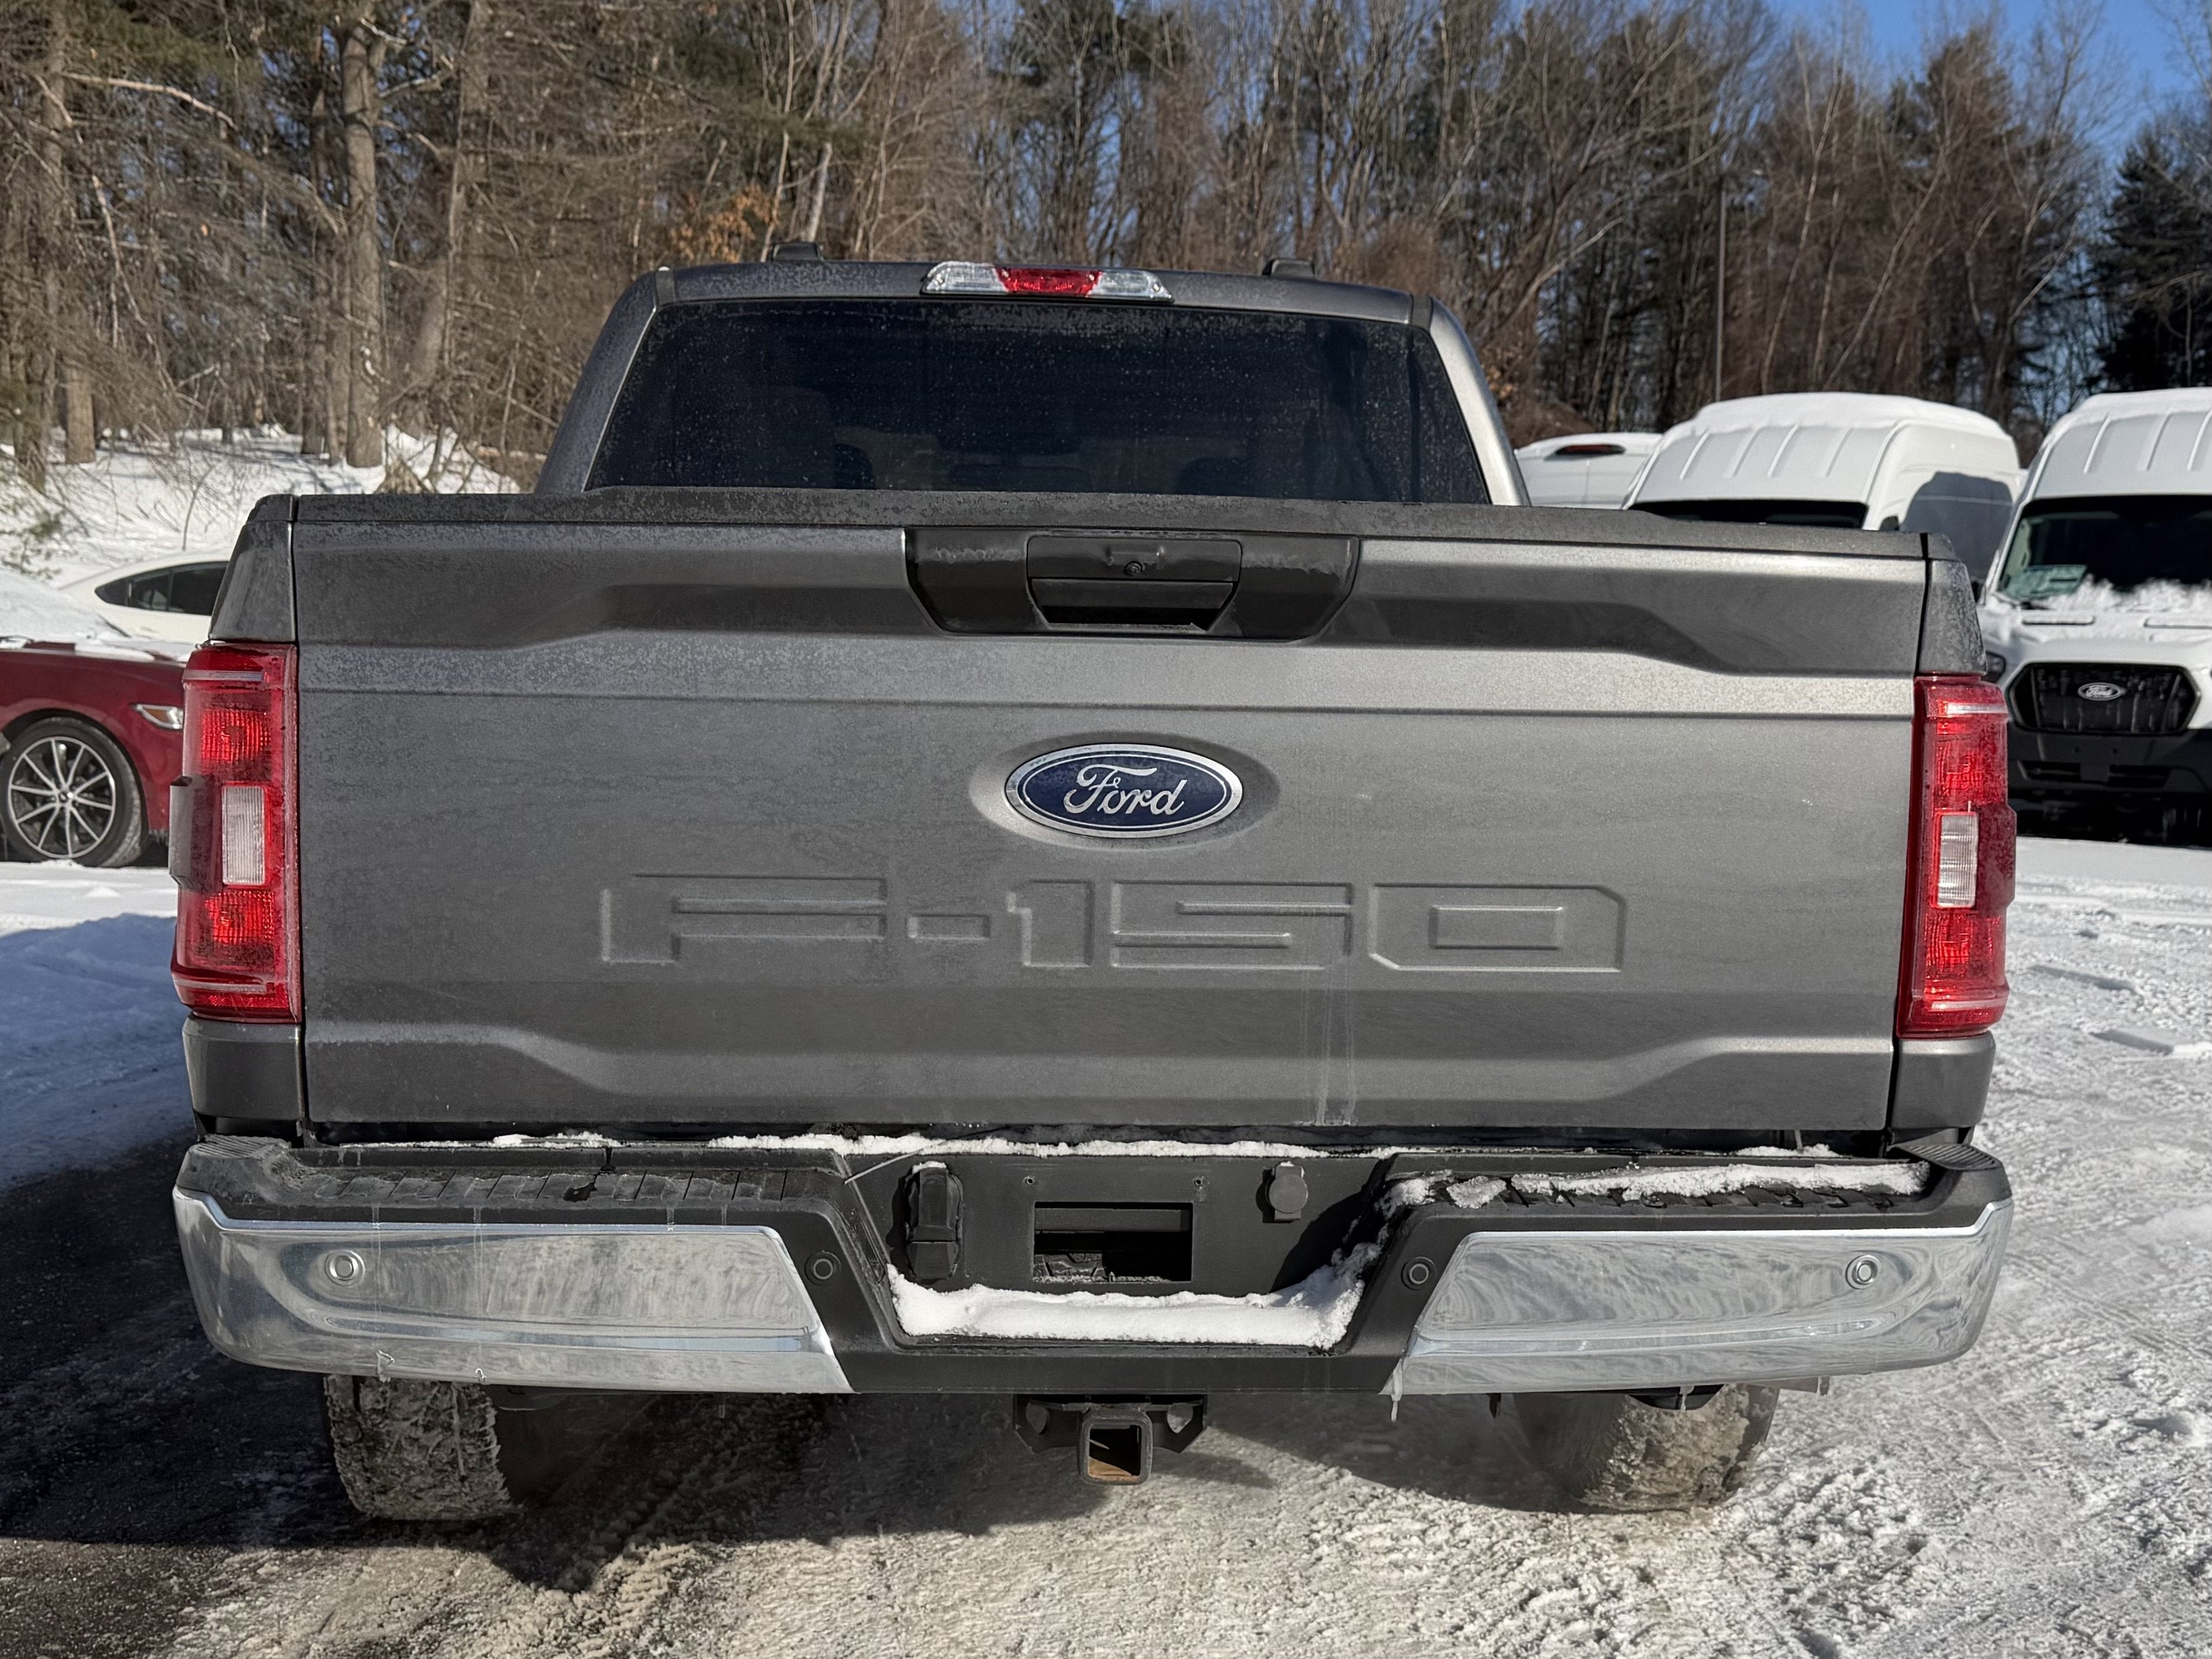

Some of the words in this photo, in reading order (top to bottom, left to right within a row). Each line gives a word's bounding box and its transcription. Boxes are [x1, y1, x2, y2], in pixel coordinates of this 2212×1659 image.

[2085, 685, 2112, 698] Ford
[1063, 764, 1188, 815] Ford
[600, 874, 1626, 974] F-150
